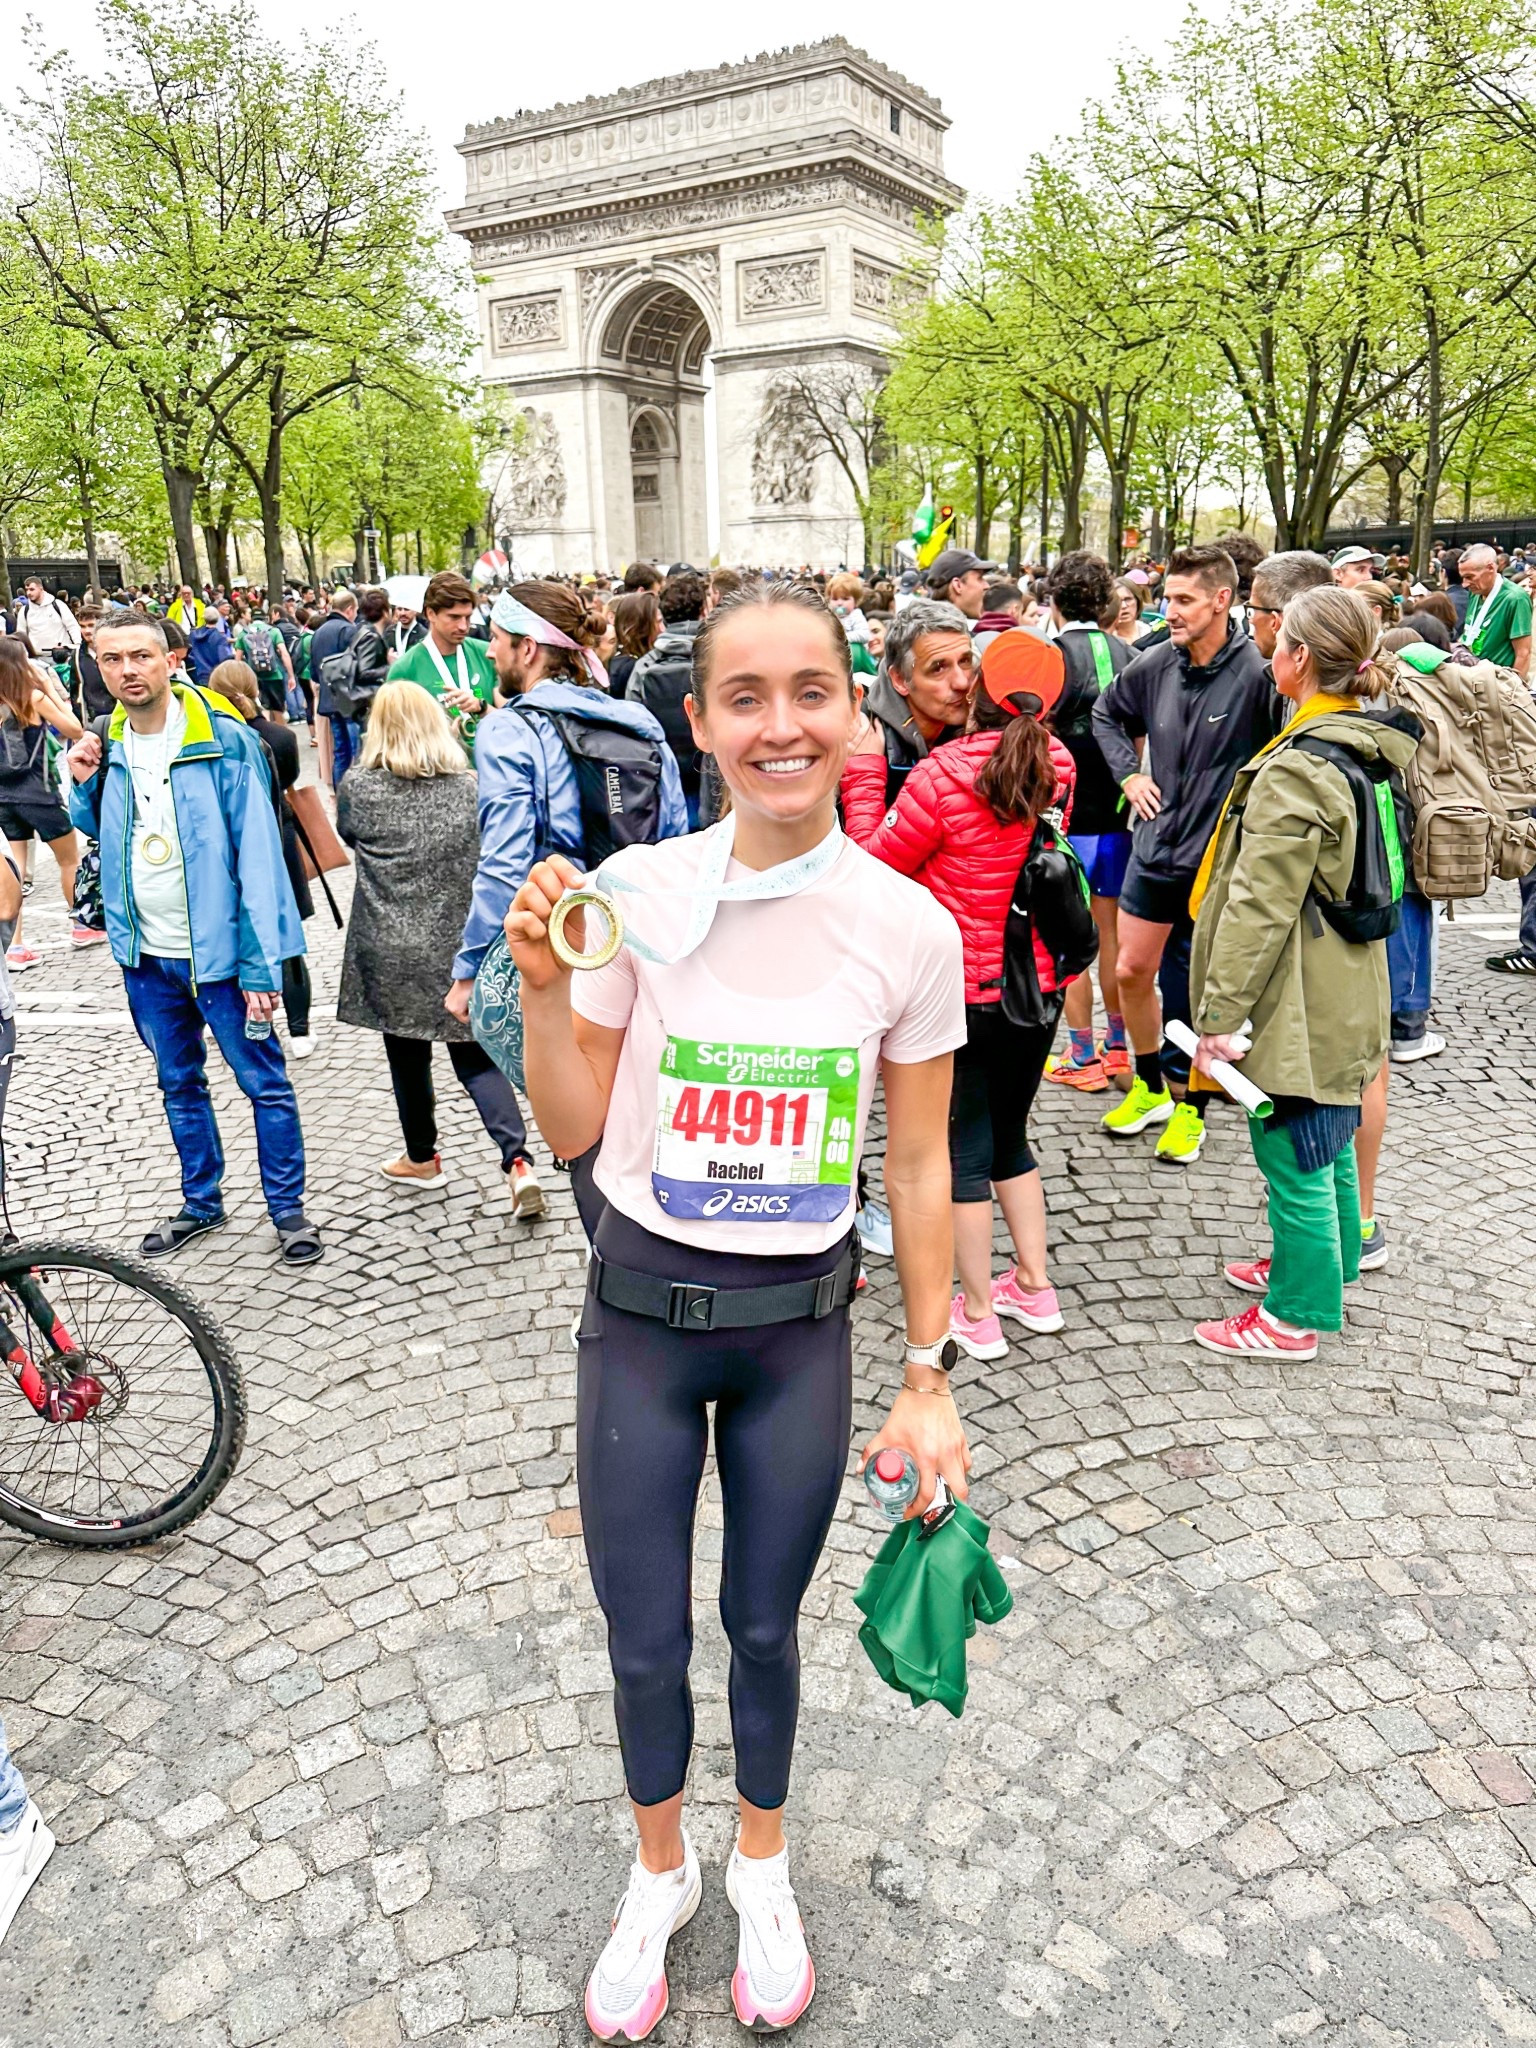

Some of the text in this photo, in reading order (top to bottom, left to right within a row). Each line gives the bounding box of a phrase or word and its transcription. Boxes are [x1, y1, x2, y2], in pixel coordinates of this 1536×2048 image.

[606, 765, 624, 815] CAMELBAK
[665, 1055, 676, 1069] 24
[697, 1043, 824, 1070] Schneider
[750, 1068, 820, 1084] Electric
[672, 1086, 809, 1146] 44911
[828, 1117, 851, 1140] 4h
[825, 1140, 849, 1163] 00
[707, 1160, 764, 1180] Rachel
